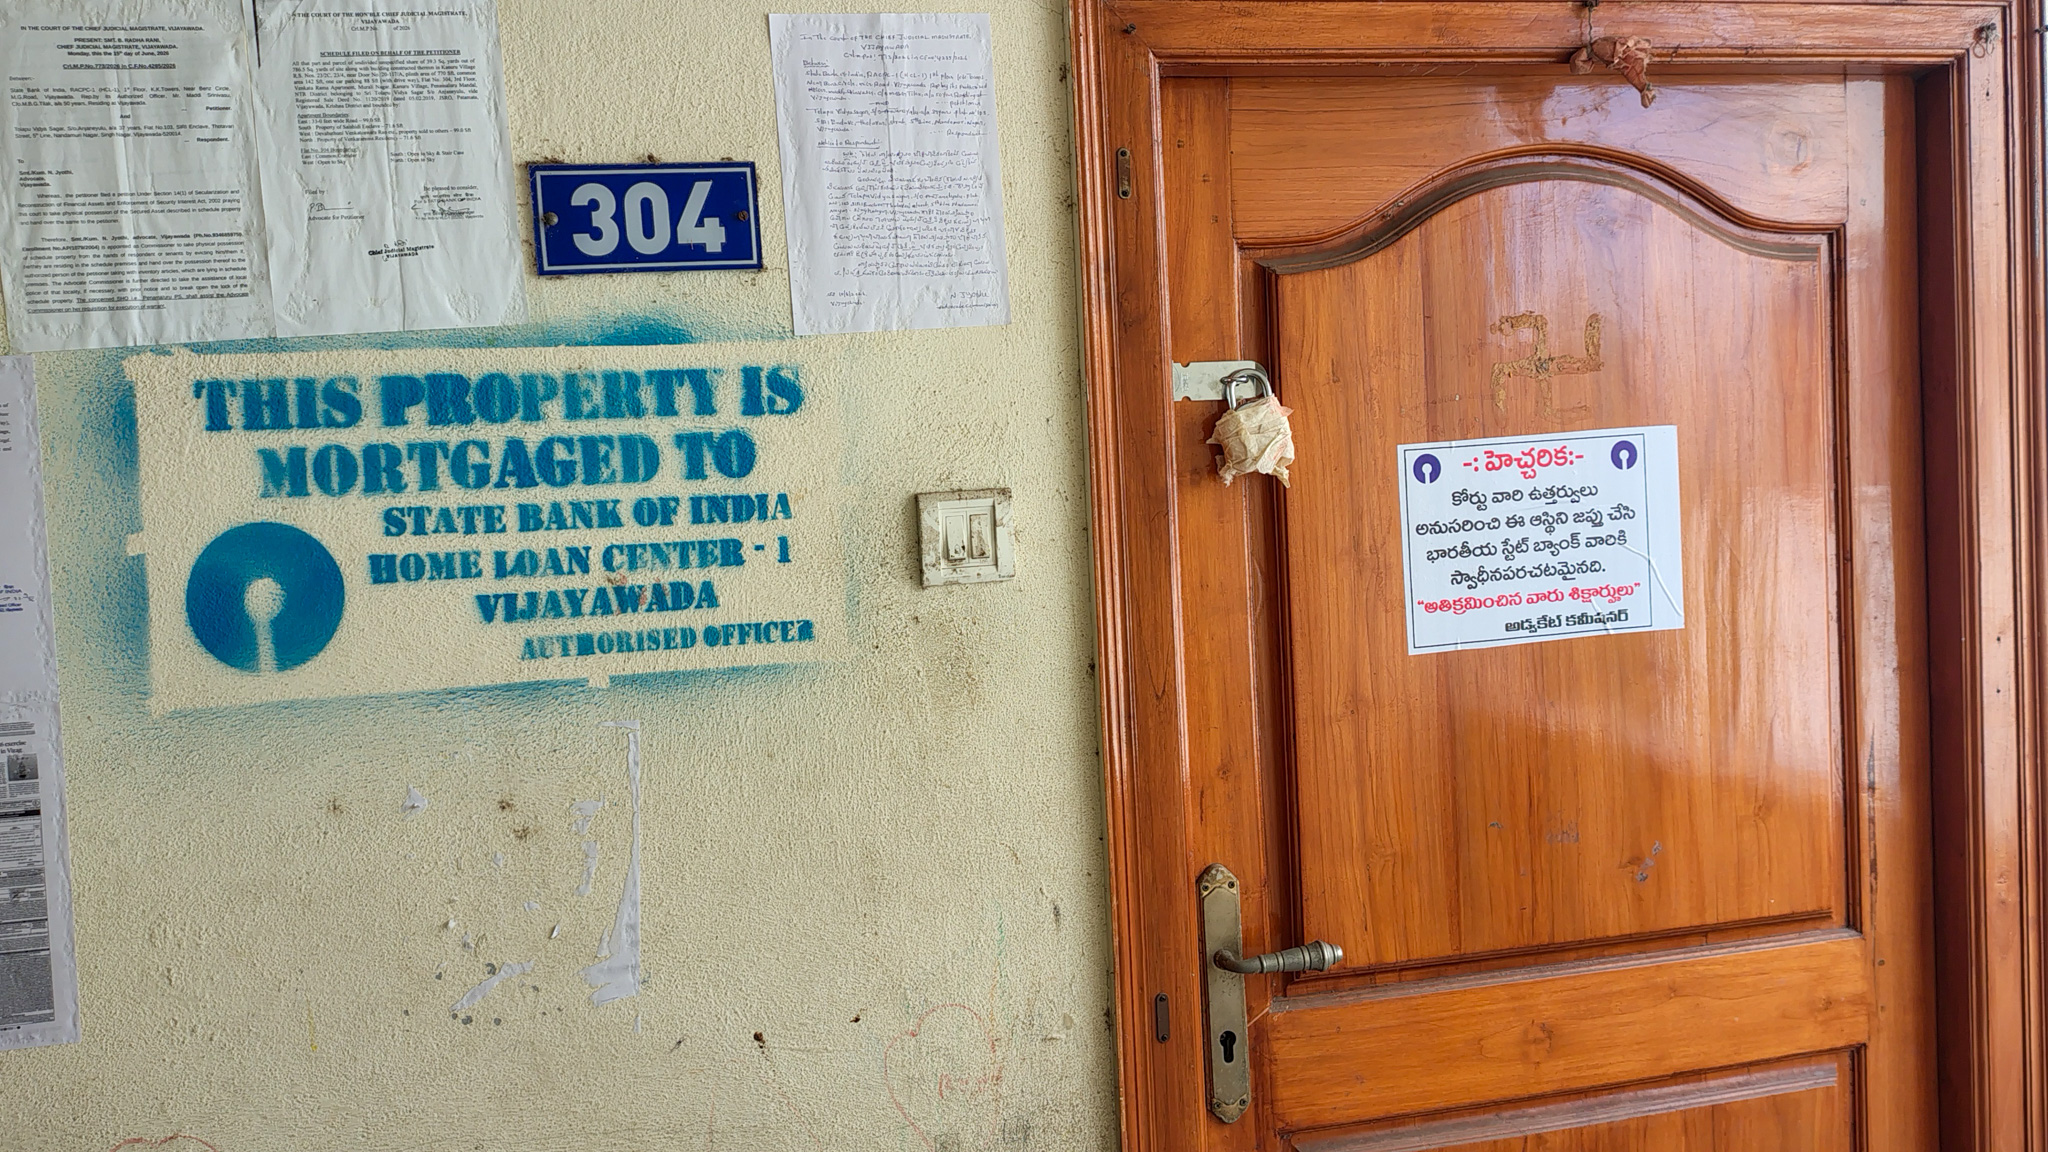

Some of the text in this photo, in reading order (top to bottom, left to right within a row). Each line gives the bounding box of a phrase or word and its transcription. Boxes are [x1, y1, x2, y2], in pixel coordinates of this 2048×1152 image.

[571, 181, 726, 257] 304
[406, 244, 435, 252] Magistrate
[194, 364, 806, 432] THIS PROPERTY IS
[258, 429, 757, 498] MORTGAGED TO
[383, 493, 792, 538] STATE BANK OF INDIA
[1451, 485, 1598, 511] కోర్టు వారి ఉత్తర్వులు
[1415, 516, 1501, 537] అనుసరించి
[1505, 514, 1525, 528] ఈ
[1572, 508, 1604, 528] జప్తు
[1607, 502, 1636, 521] చేసి
[368, 549, 483, 585] HOME
[493, 546, 591, 580] LOAN
[601, 538, 746, 574] CENTER
[777, 536, 791, 563] 1
[1426, 529, 1627, 563] భారతీయ స్టేట్ బ్యాంక్ వారికి
[475, 580, 720, 623] VIJAYAWADA
[1526, 588, 1564, 604] వారు
[521, 619, 815, 660] AUTHORISED OFFICER
[1505, 614, 1562, 633] అడ్వకేట్
